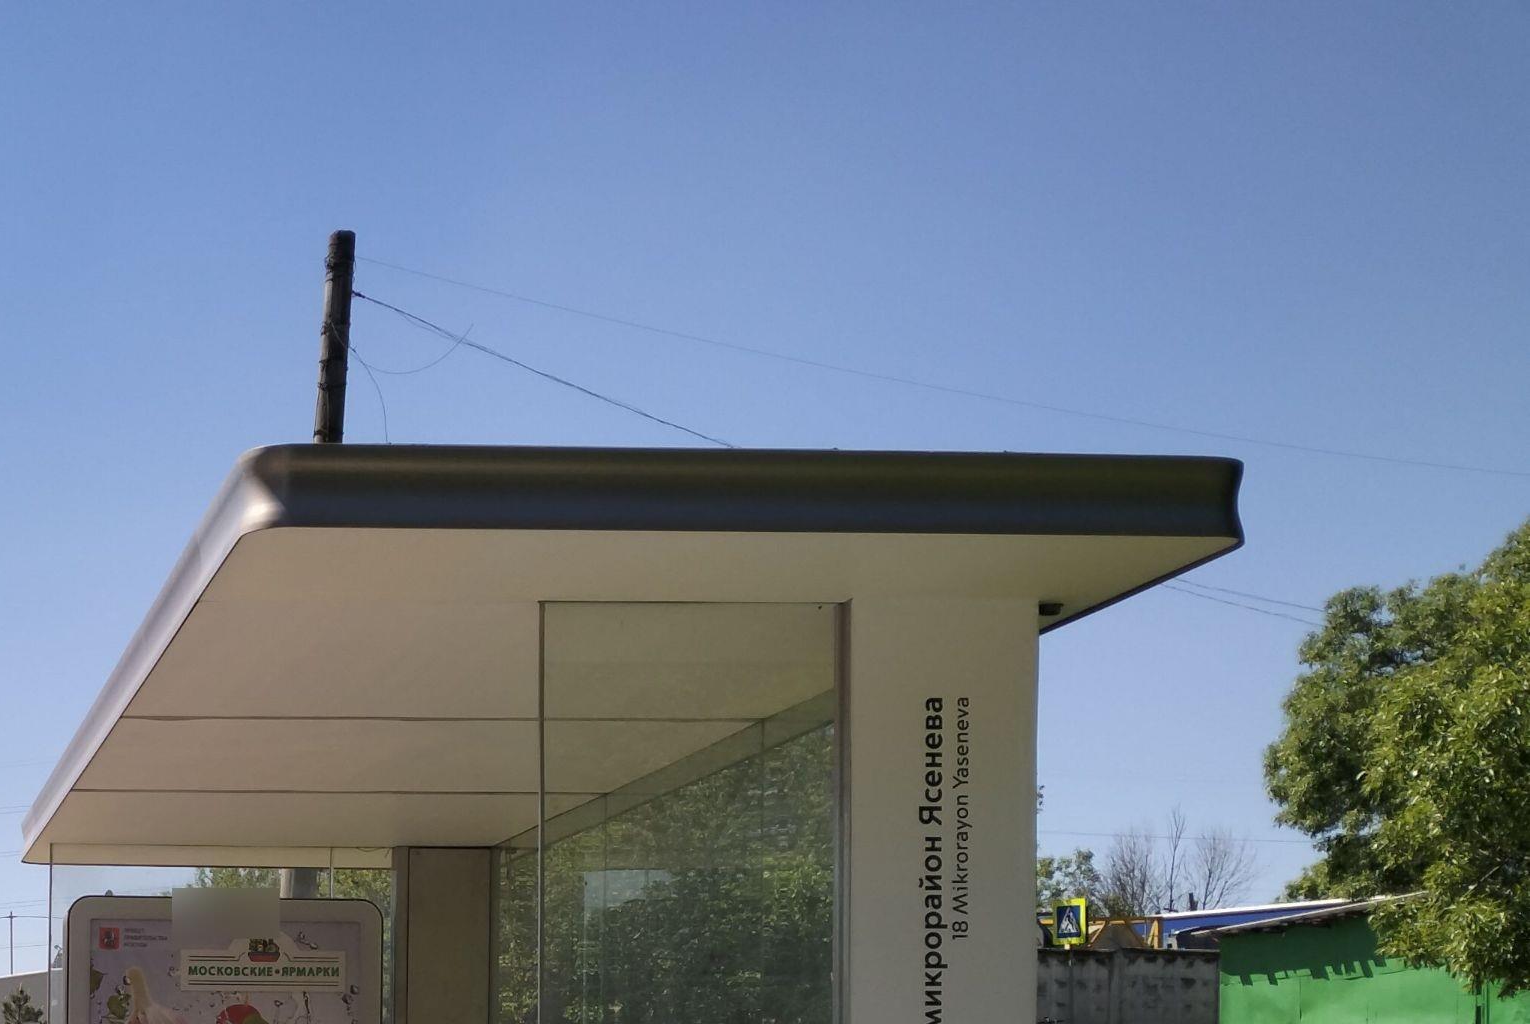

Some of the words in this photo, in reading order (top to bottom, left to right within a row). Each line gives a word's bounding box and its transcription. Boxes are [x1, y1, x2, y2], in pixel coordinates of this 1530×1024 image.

[918, 697, 943, 826] Ясенева
[952, 697, 970, 790] Yaseneva
[952, 794, 973, 913] Mikrorayon
[188, 965, 273, 977] МОСКОВСКИЕ
[281, 966, 340, 977] ЯРМАРКИ
[952, 920, 969, 940] 18
